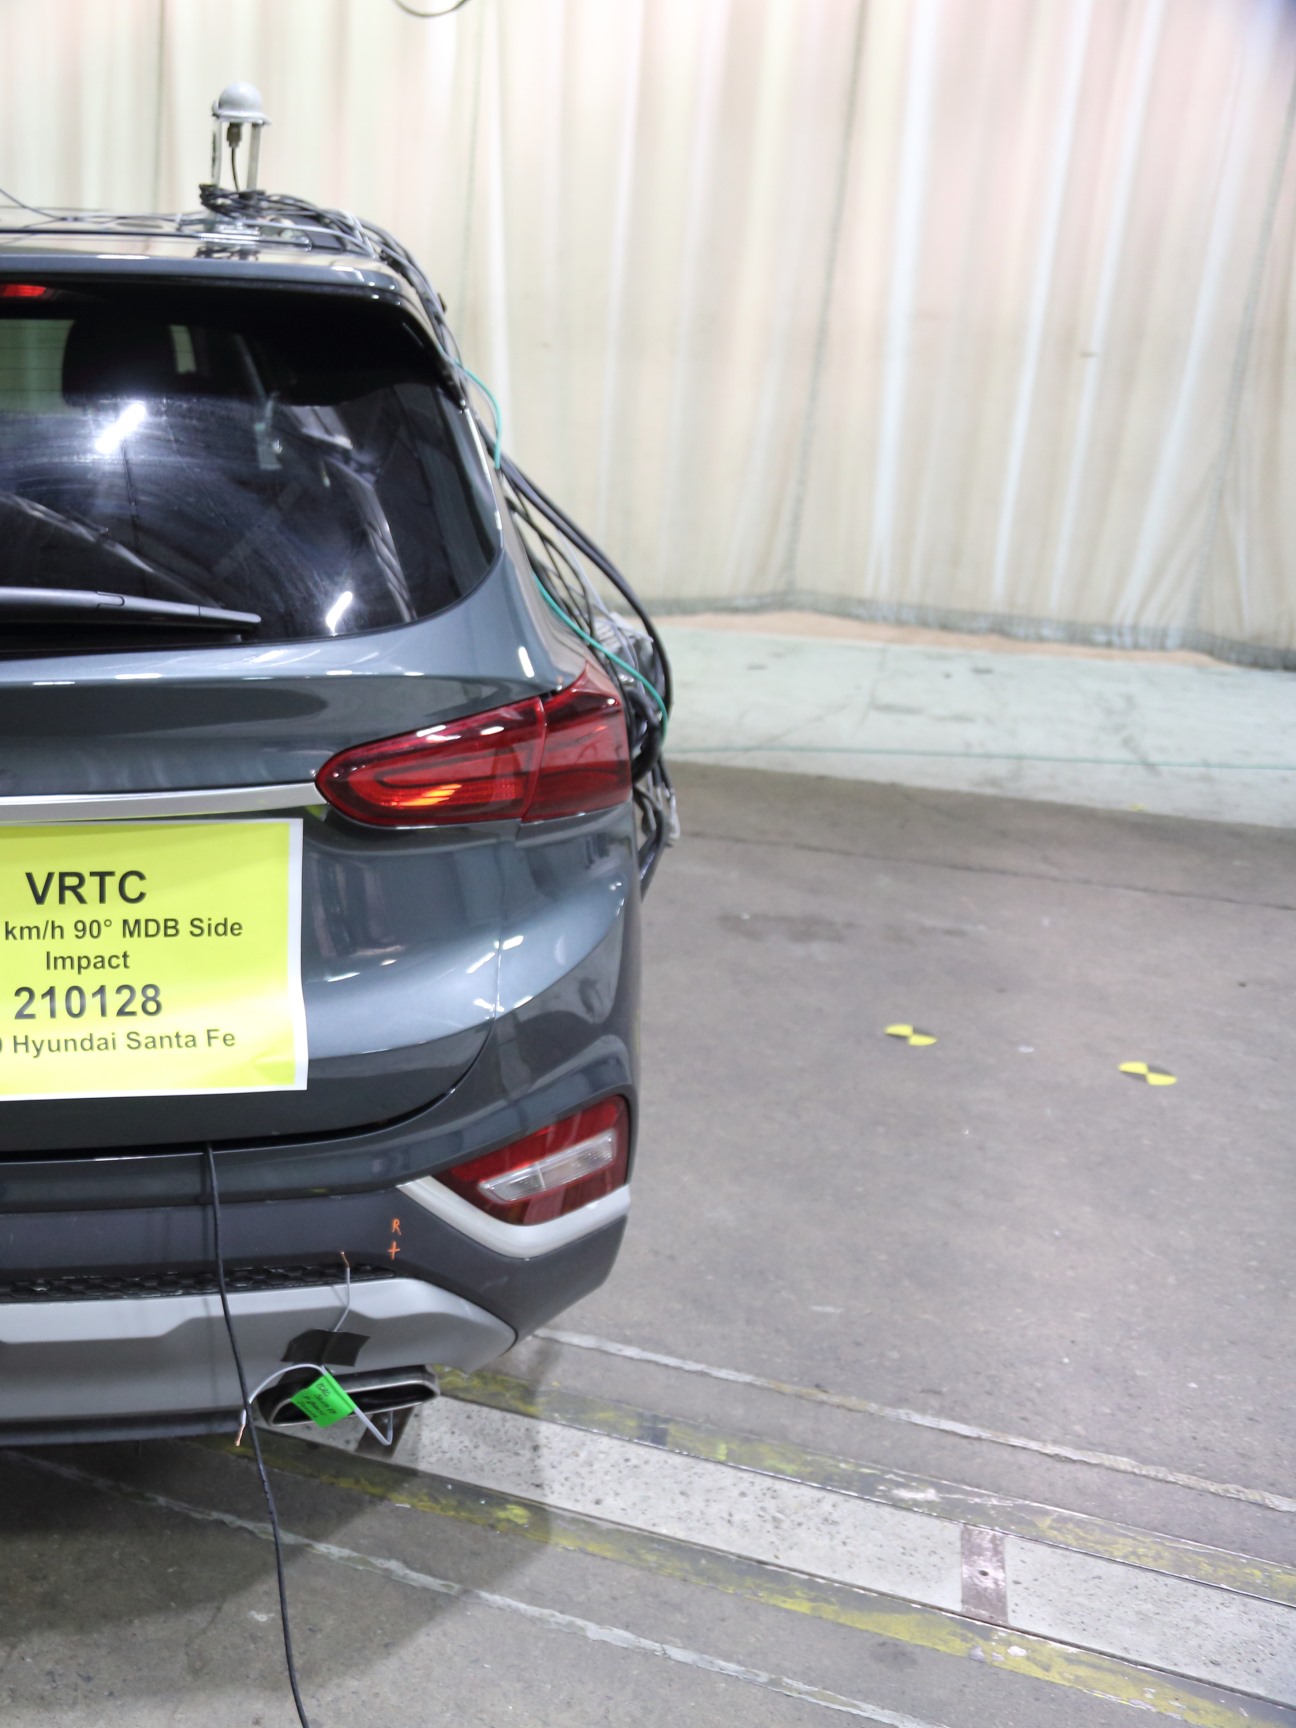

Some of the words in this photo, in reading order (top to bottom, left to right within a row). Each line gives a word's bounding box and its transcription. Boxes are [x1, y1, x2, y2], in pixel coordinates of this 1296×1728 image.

[24, 869, 147, 906] VRTC
[4, 919, 65, 941] km/h
[74, 918, 113, 940] 90°
[122, 918, 181, 939] MDB
[189, 917, 243, 938] Side
[45, 951, 130, 975] Impact
[14, 983, 163, 1020] 210128
[12, 1032, 117, 1058] Hyundai
[126, 1029, 200, 1051] Santa
[207, 1029, 236, 1047] Fe
